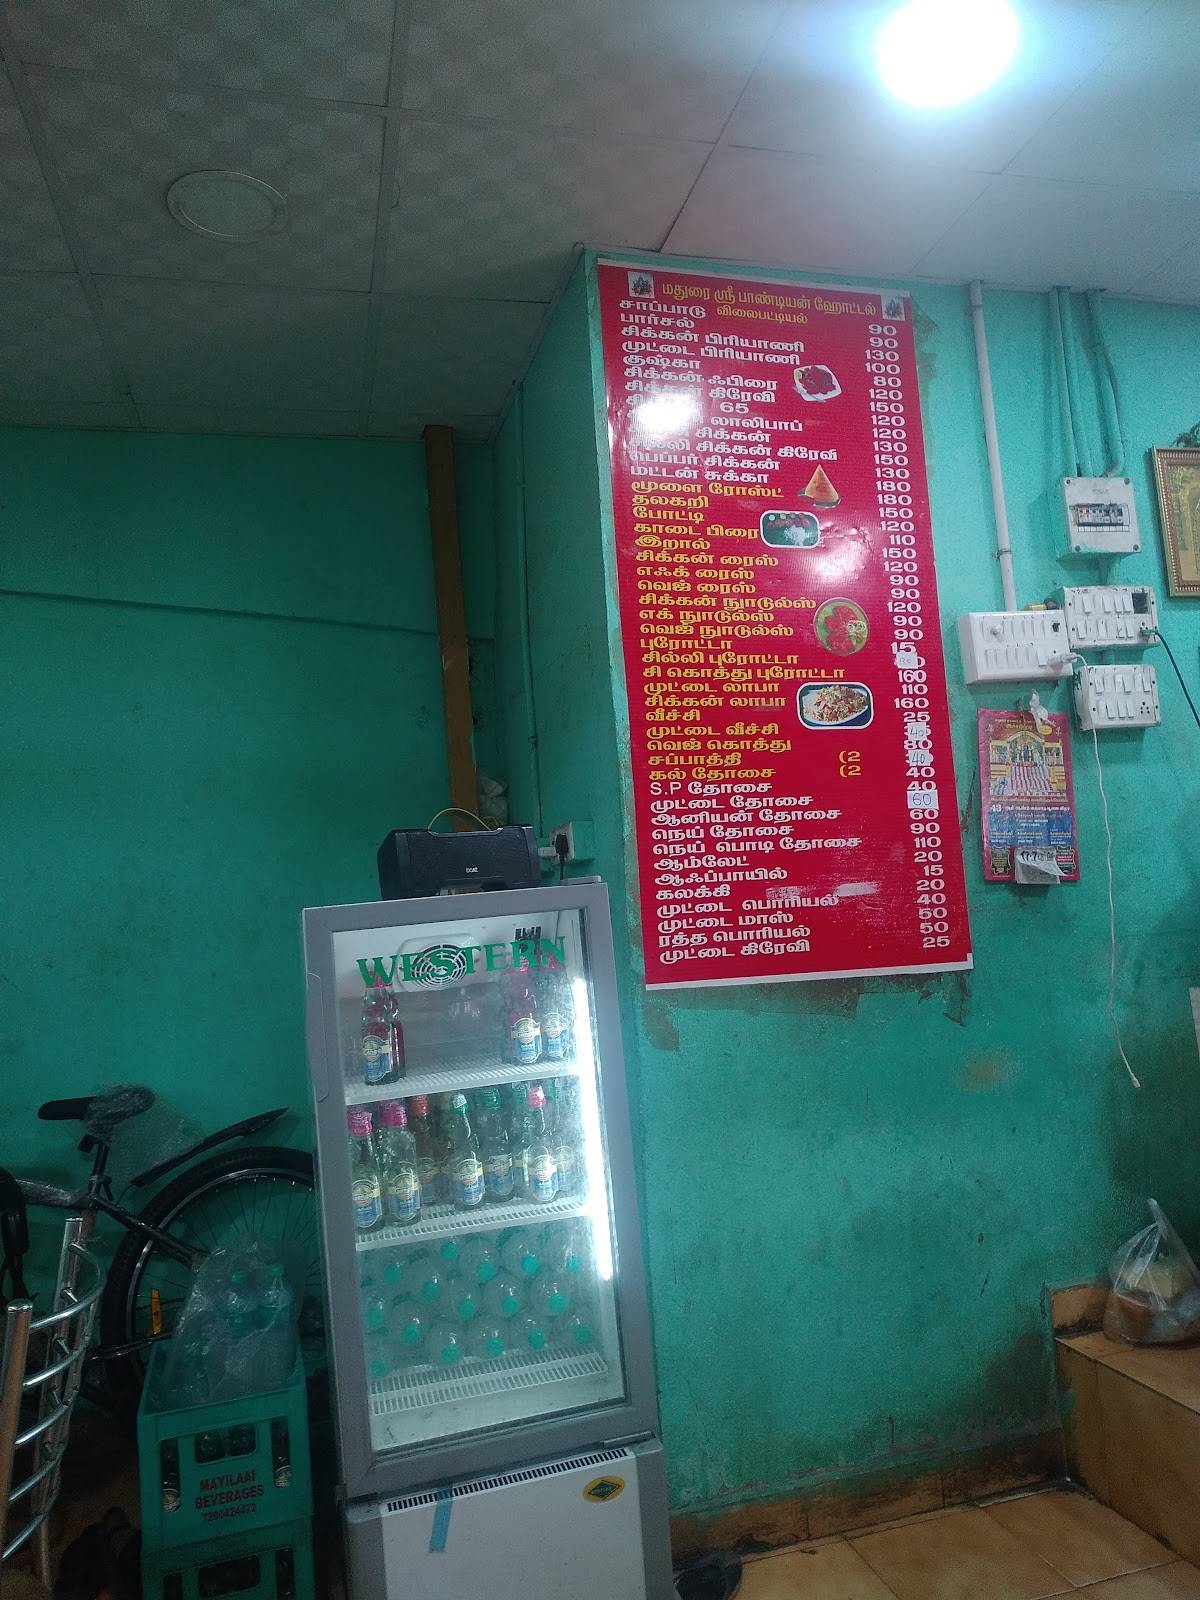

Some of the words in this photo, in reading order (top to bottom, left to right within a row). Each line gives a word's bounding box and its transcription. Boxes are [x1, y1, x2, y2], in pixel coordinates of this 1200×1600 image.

[663, 283, 710, 300] மதுரை
[738, 291, 811, 310] பாண்டியன்
[814, 296, 877, 316] ஹோட்டல்
[620, 299, 706, 318] சாப்பாடு
[620, 313, 695, 328] பார்சல்
[868, 324, 897, 335] 90
[621, 325, 699, 342] சிக்கன்
[704, 332, 804, 352] பிரியாணி
[869, 336, 898, 349] 90
[622, 340, 695, 356] முட்டை
[700, 345, 800, 365] பிரியாணி
[865, 349, 899, 362] 130
[624, 366, 703, 383] சிக்கன்
[865, 362, 901, 375] 100
[873, 375, 902, 388] 80
[869, 388, 903, 401] 120
[719, 402, 749, 414] 65
[869, 401, 904, 414] 150
[711, 416, 803, 432] லாலிபாப்
[871, 414, 905, 427] 120
[696, 427, 771, 443] சிக்கன்
[872, 427, 906, 440] 120
[696, 441, 772, 457] சிக்கன்
[777, 446, 838, 461] கிரேவி
[873, 440, 908, 453] 130
[704, 455, 780, 471] சிக்கன்
[873, 454, 909, 466] 150
[630, 464, 699, 480] மட்டன்
[875, 467, 910, 479] 130
[876, 480, 911, 492] 180
[877, 493, 912, 505] 180
[632, 506, 705, 524] போட்டி
[879, 507, 913, 519] 150
[634, 522, 701, 536] காடை
[706, 525, 759, 540] பிரை
[880, 520, 915, 532] 120
[635, 535, 711, 550] இறால்
[889, 534, 916, 546] 110
[636, 550, 714, 565] சிக்கன்
[719, 553, 779, 567] ரைஸ்
[882, 547, 917, 560] 150
[695, 566, 755, 581] ரைஸ்
[884, 561, 918, 573] 120
[638, 579, 691, 592] வெஜ்
[697, 580, 756, 594] ரைஸ்
[889, 574, 919, 586] 90
[639, 593, 717, 608] சிக்கன்
[890, 588, 920, 600] 90
[887, 601, 921, 613] 120
[640, 608, 674, 621] எக்
[893, 615, 922, 627] 90
[640, 621, 694, 636] வெஜ்
[893, 629, 923, 640] 90
[641, 636, 732, 652] புரோட்டா
[890, 641, 917, 654] 15
[642, 650, 705, 665] சில்லி
[709, 652, 799, 666] புரோட்டா
[643, 665, 661, 679] சி
[667, 665, 752, 681] கொத்து
[756, 665, 845, 680] புரோட்டா
[898, 669, 927, 683] 160
[644, 681, 717, 696] முட்டை
[722, 682, 780, 693] லாபா
[901, 683, 928, 695] 110
[645, 694, 724, 708] சிக்கன்
[730, 696, 786, 708] லாபா
[893, 697, 929, 709] 160
[903, 711, 931, 723] 25
[646, 724, 720, 739] முட்டை
[647, 738, 701, 752] வெஜ்
[707, 738, 792, 753] கொத்து
[903, 739, 933, 750] 80
[648, 752, 742, 768] சப்பாத்தி
[838, 750, 861, 764] (2
[649, 767, 687, 781] கல்
[692, 766, 776, 782] தோசை
[838, 765, 862, 778] (2
[905, 766, 935, 778] 40
[650, 781, 682, 795] S.P
[687, 781, 773, 797] தோசை
[907, 780, 937, 791] 40
[651, 797, 726, 813] முட்டை
[729, 795, 813, 810] தோசை
[913, 792, 932, 806] 60
[651, 810, 754, 827] ஆனியன்
[758, 808, 842, 824] தோசை
[909, 808, 939, 820] 60
[652, 826, 705, 842] நெய்
[709, 823, 794, 840] தோசை
[910, 822, 940, 834] 90
[652, 840, 706, 857] நெய்
[716, 840, 776, 854] பொடி
[779, 836, 862, 852] தோசை
[914, 836, 941, 848] 110
[914, 850, 943, 863] 20
[923, 864, 944, 876] 15
[916, 879, 945, 891] 20
[655, 884, 732, 900] கலக்கி
[917, 892, 946, 905] 40
[656, 900, 733, 919] முட்டை
[742, 894, 839, 911] பொரியல்
[918, 907, 947, 919] 50
[657, 916, 733, 934] முட்டை
[738, 911, 794, 926] மாஸ்
[920, 921, 949, 933] 50
[658, 931, 708, 948] ரத்த
[713, 924, 811, 942] பொரியல்
[922, 935, 951, 948] 25
[659, 947, 735, 965] முட்டை
[740, 939, 811, 957] கிரேவி
[356, 936, 566, 987] WESTERN
[195, 1484, 265, 1509] BEVERAGES
